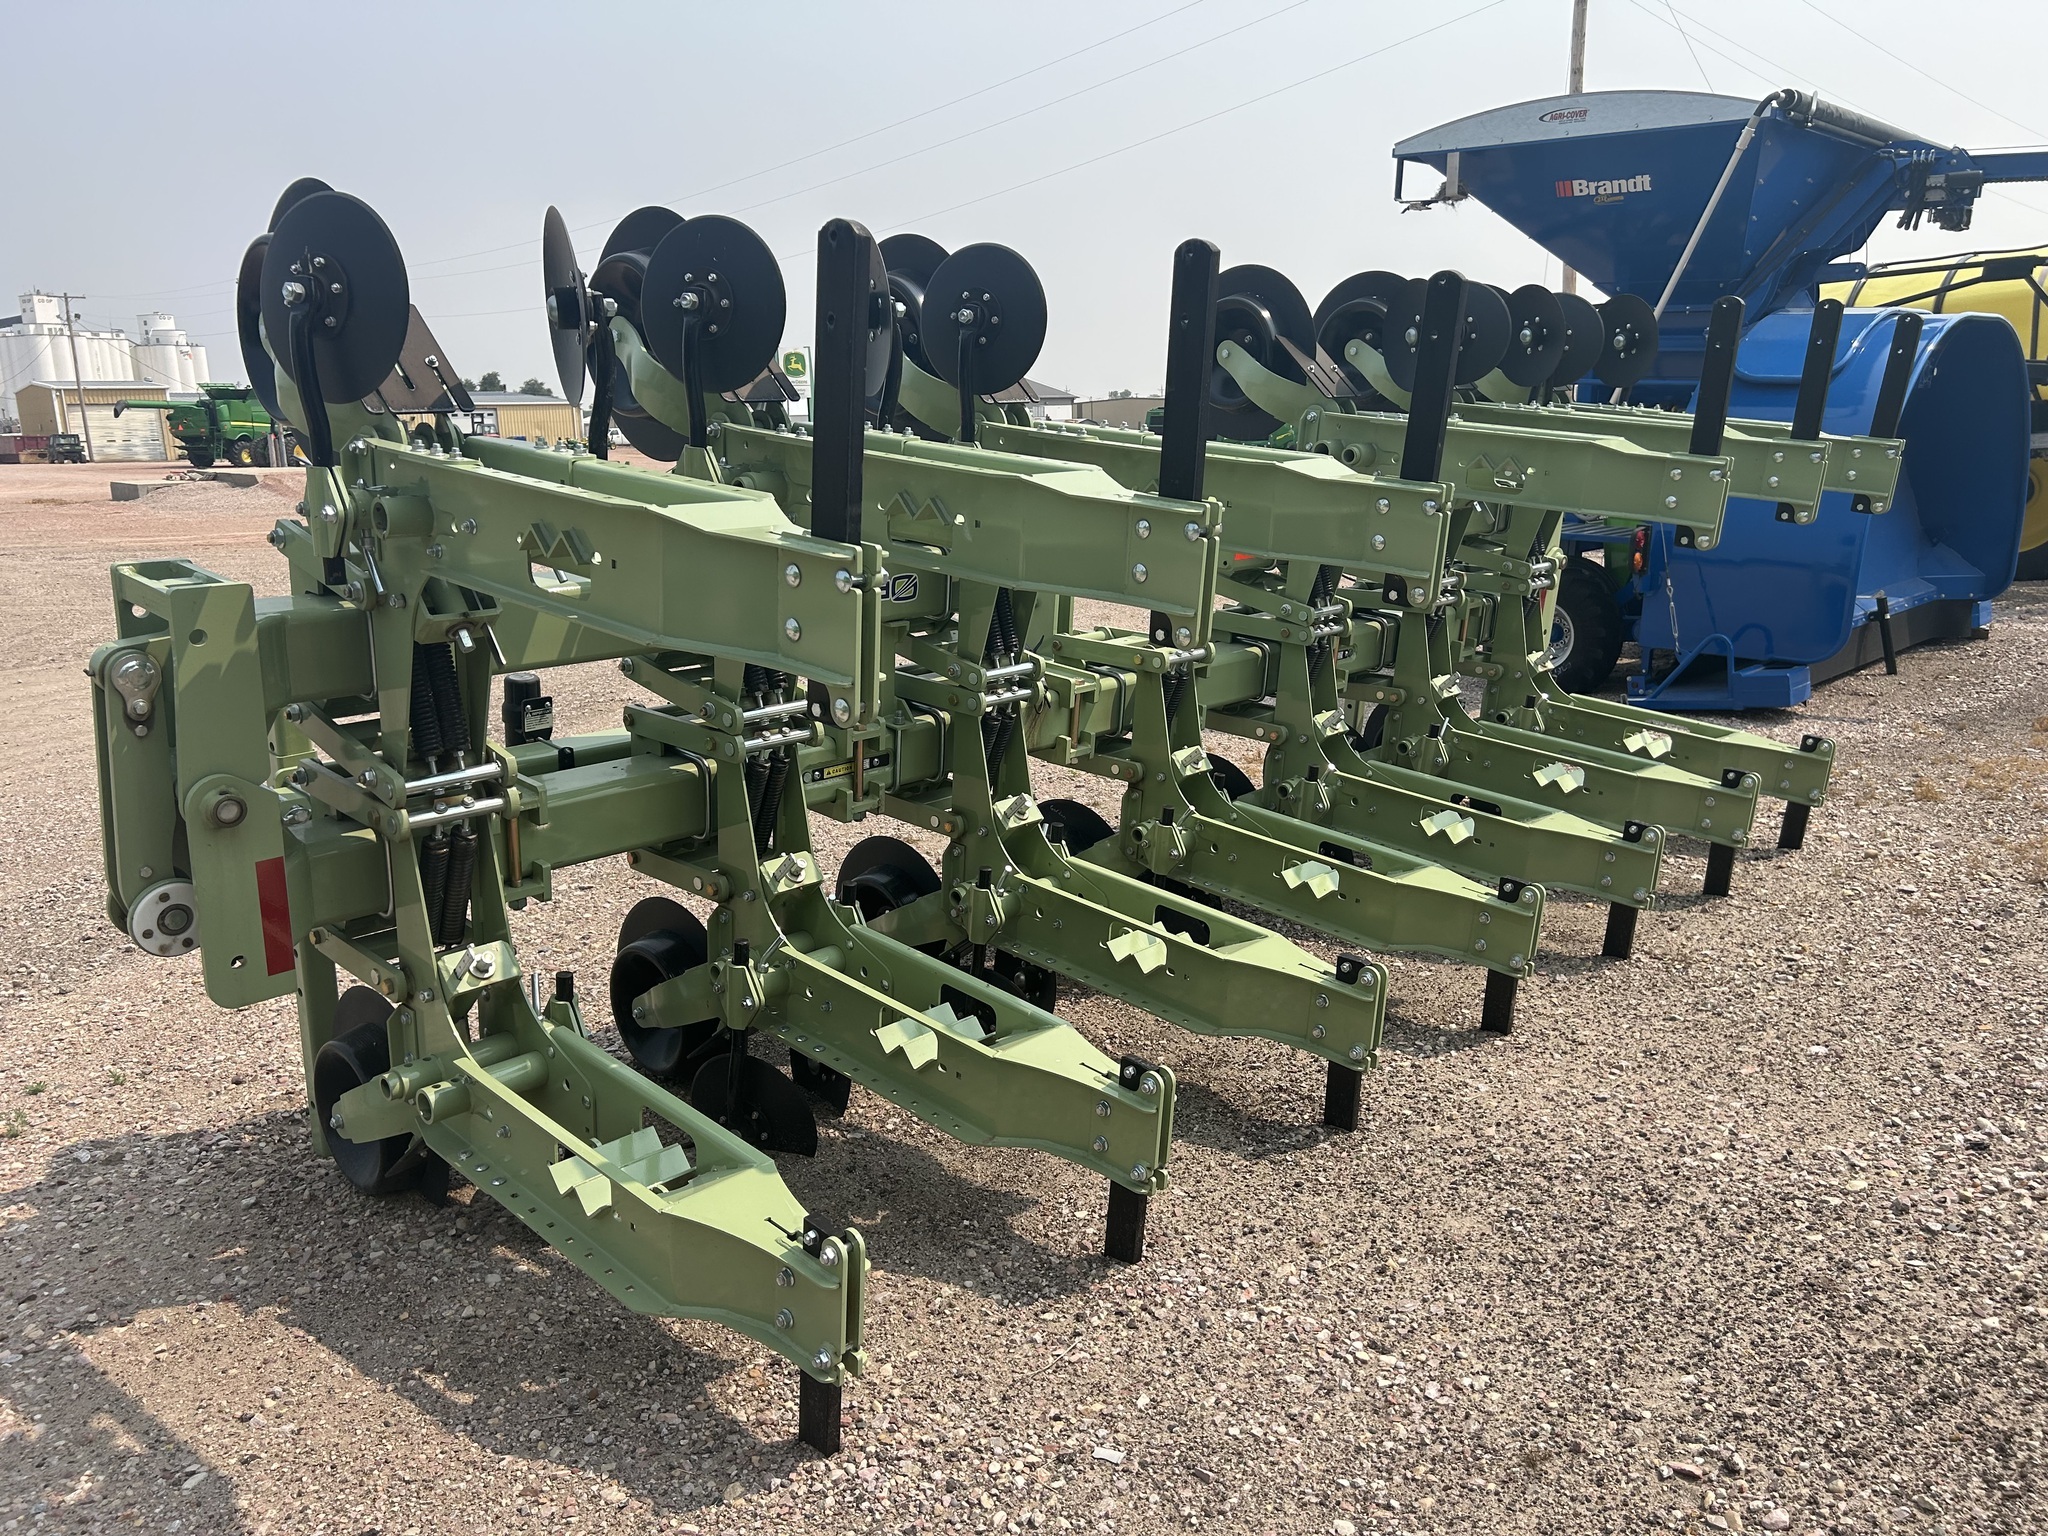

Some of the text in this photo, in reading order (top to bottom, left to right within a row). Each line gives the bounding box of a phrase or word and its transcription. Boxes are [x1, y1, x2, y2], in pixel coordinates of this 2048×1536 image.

[1549, 109, 1587, 121] AGRI-COVER
[1572, 174, 1651, 196] Brandt
[832, 766, 852, 774] CAUTION
